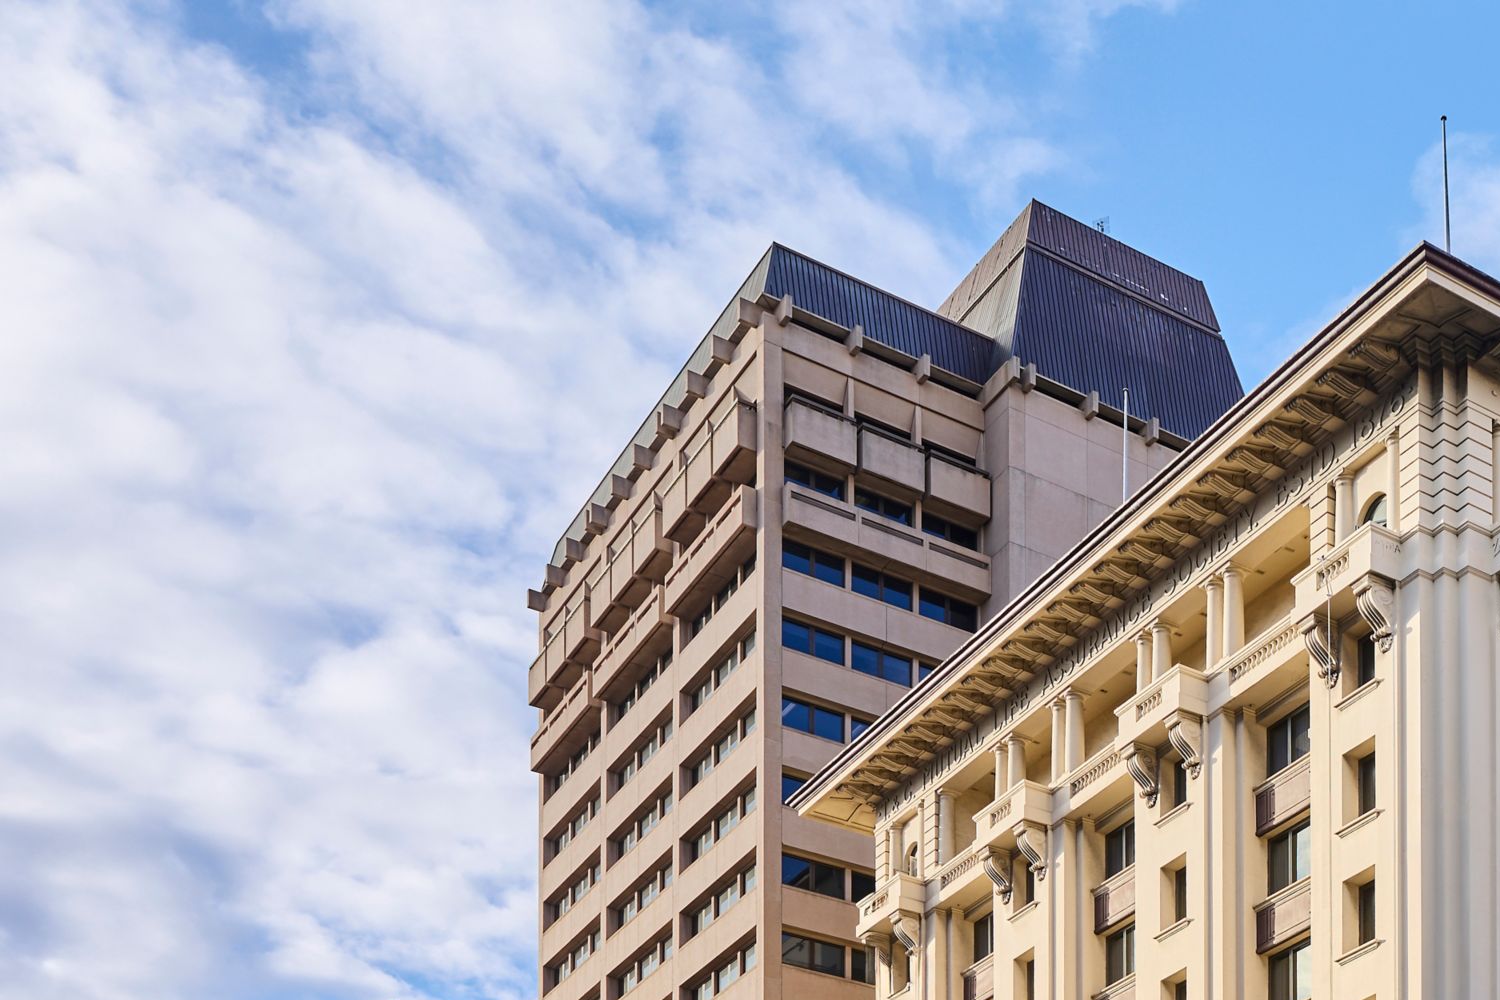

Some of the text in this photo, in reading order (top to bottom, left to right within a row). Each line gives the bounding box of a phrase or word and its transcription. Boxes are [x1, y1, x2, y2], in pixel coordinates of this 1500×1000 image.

[922, 724, 985, 790] MUTUAL
[993, 684, 1031, 735] LIFE
[1040, 591, 1153, 697] ASSURANCE
